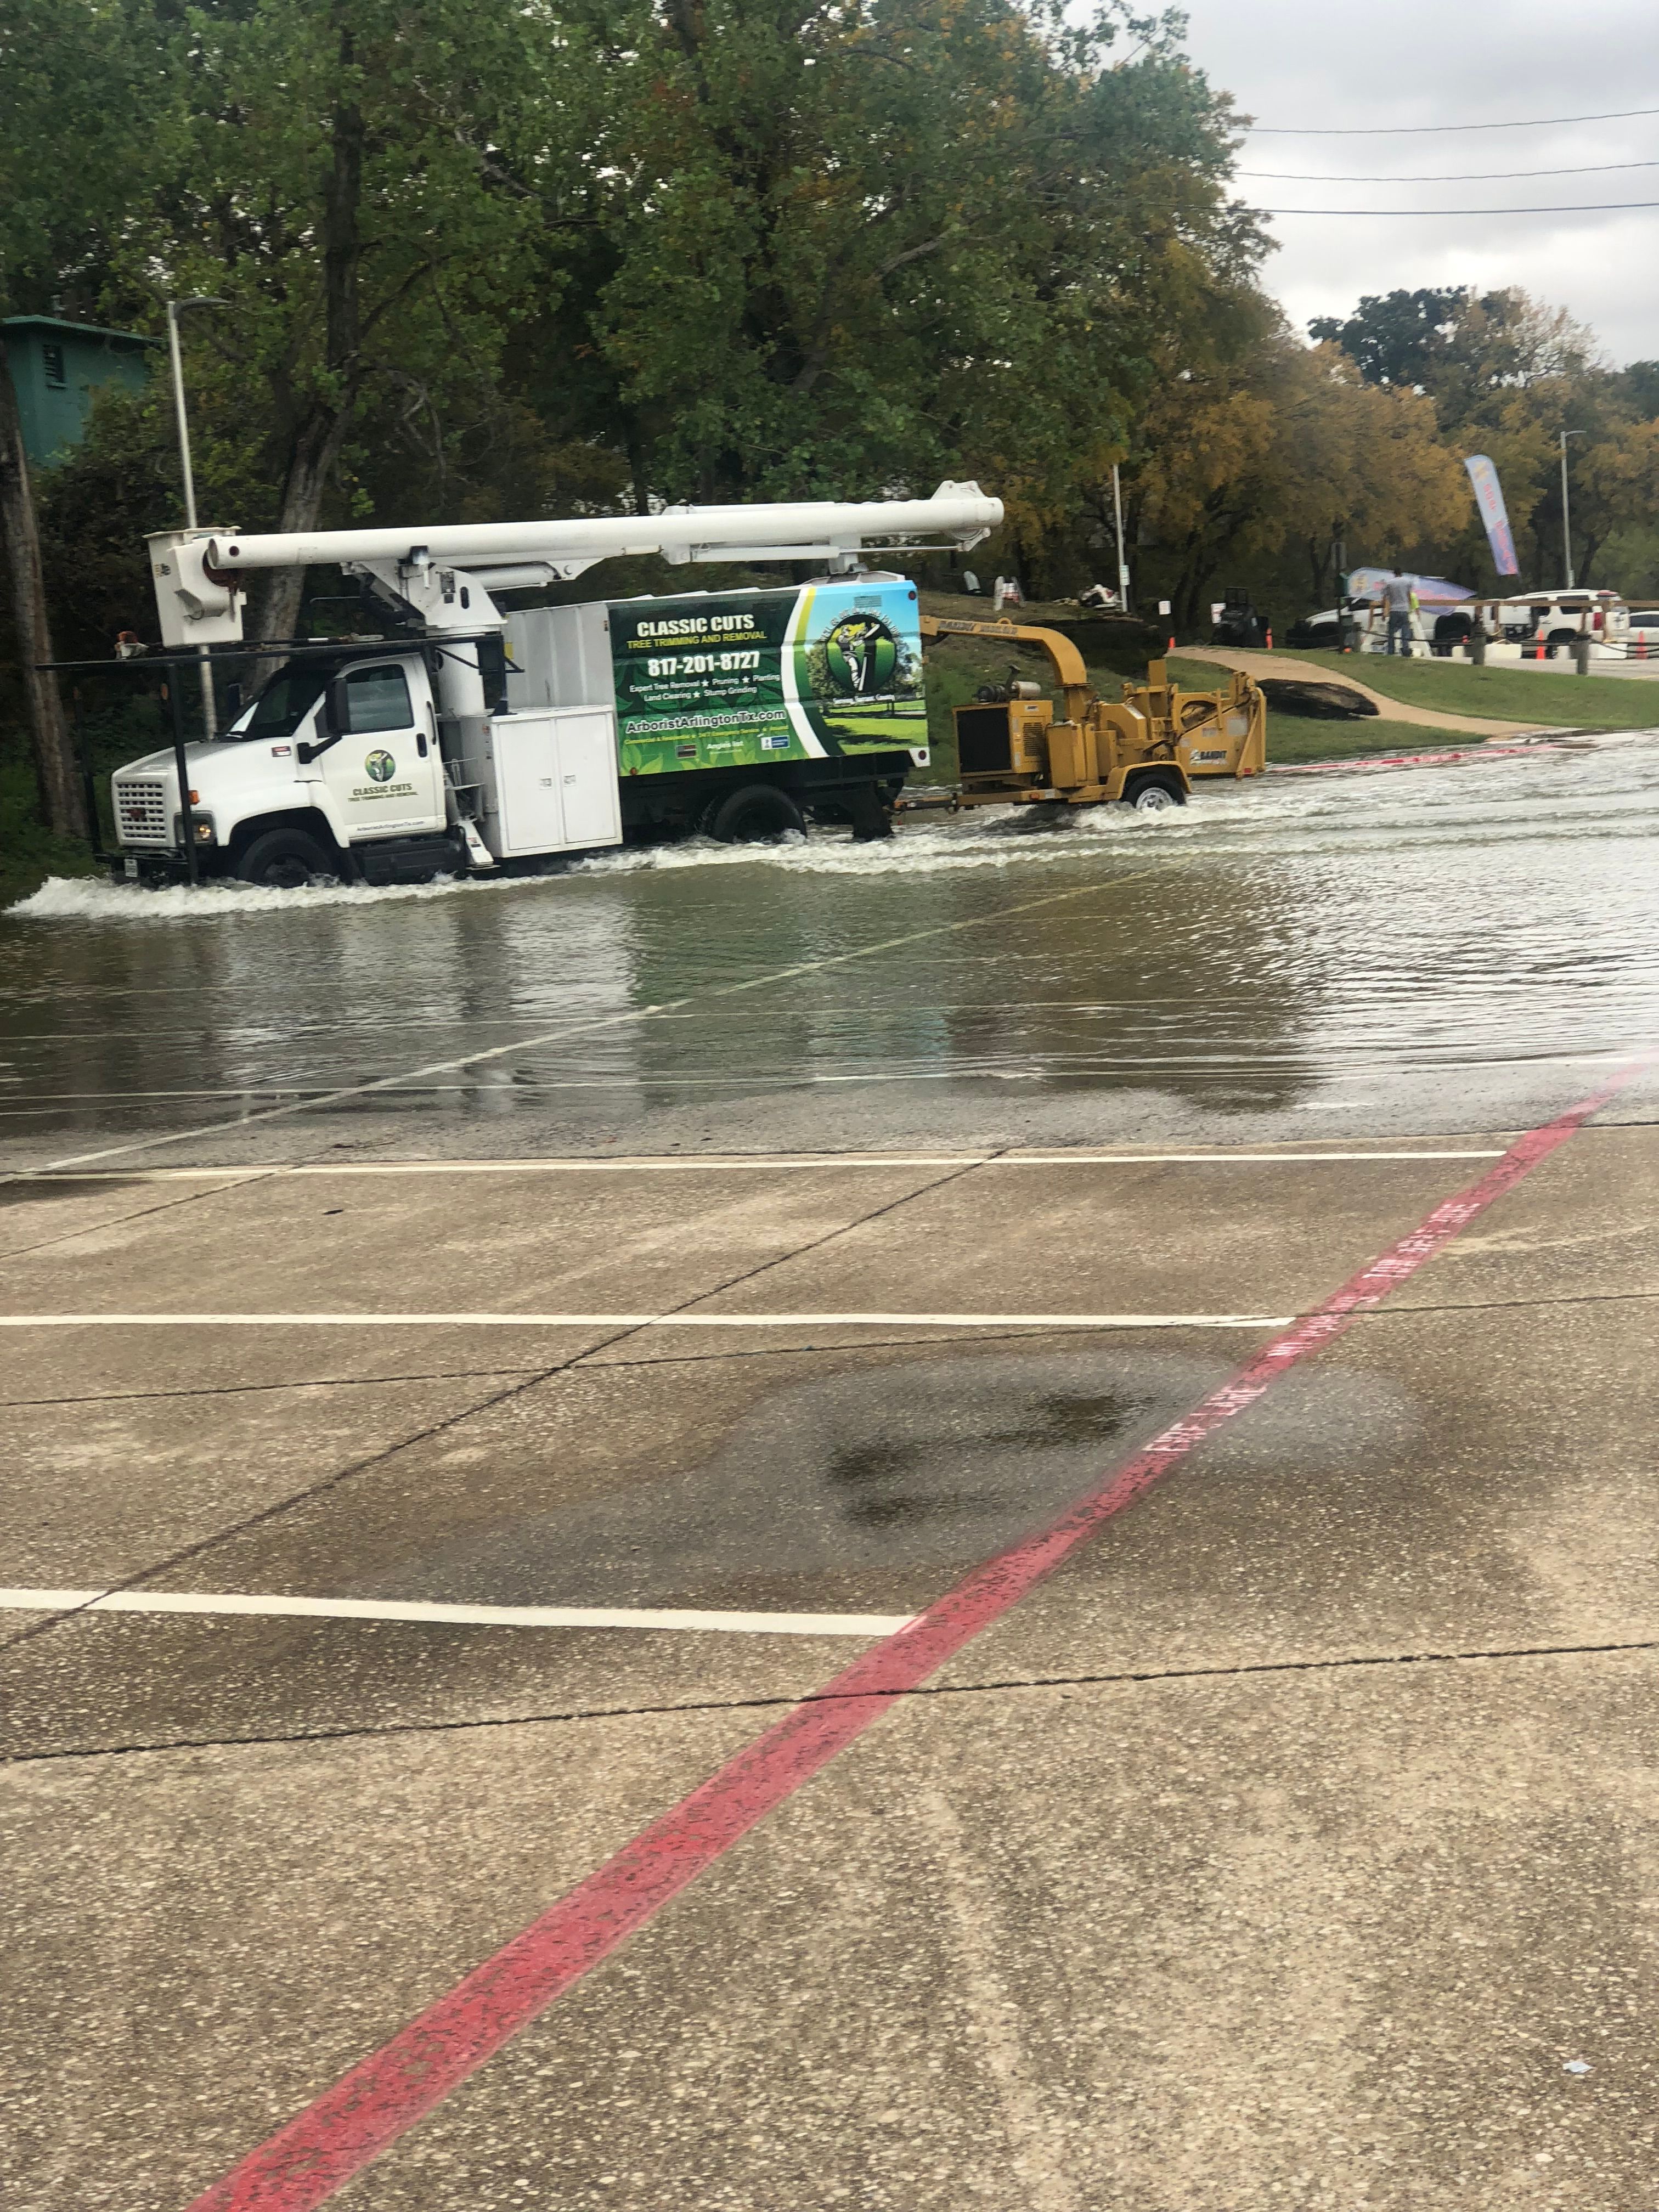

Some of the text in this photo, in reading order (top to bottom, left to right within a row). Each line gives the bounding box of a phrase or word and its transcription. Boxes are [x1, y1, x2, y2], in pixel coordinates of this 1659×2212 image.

[637, 614, 755, 637] CLASSIC CUTS
[627, 631, 768, 649] TREE TRIMMING AND REMOVAL
[647, 651, 760, 676] 817-201-8727
[629, 684, 653, 692] Expert
[670, 680, 700, 689] Removal
[662, 692, 691, 700] Clearing
[727, 686, 757, 695] Grinding
[625, 710, 786, 733] ArboristArlingtonTx.com
[353, 783, 413, 796] CLASSIC CUTS
[1141, 1423, 1224, 1451] FIRE
[1189, 1383, 1268, 1417] LANE
